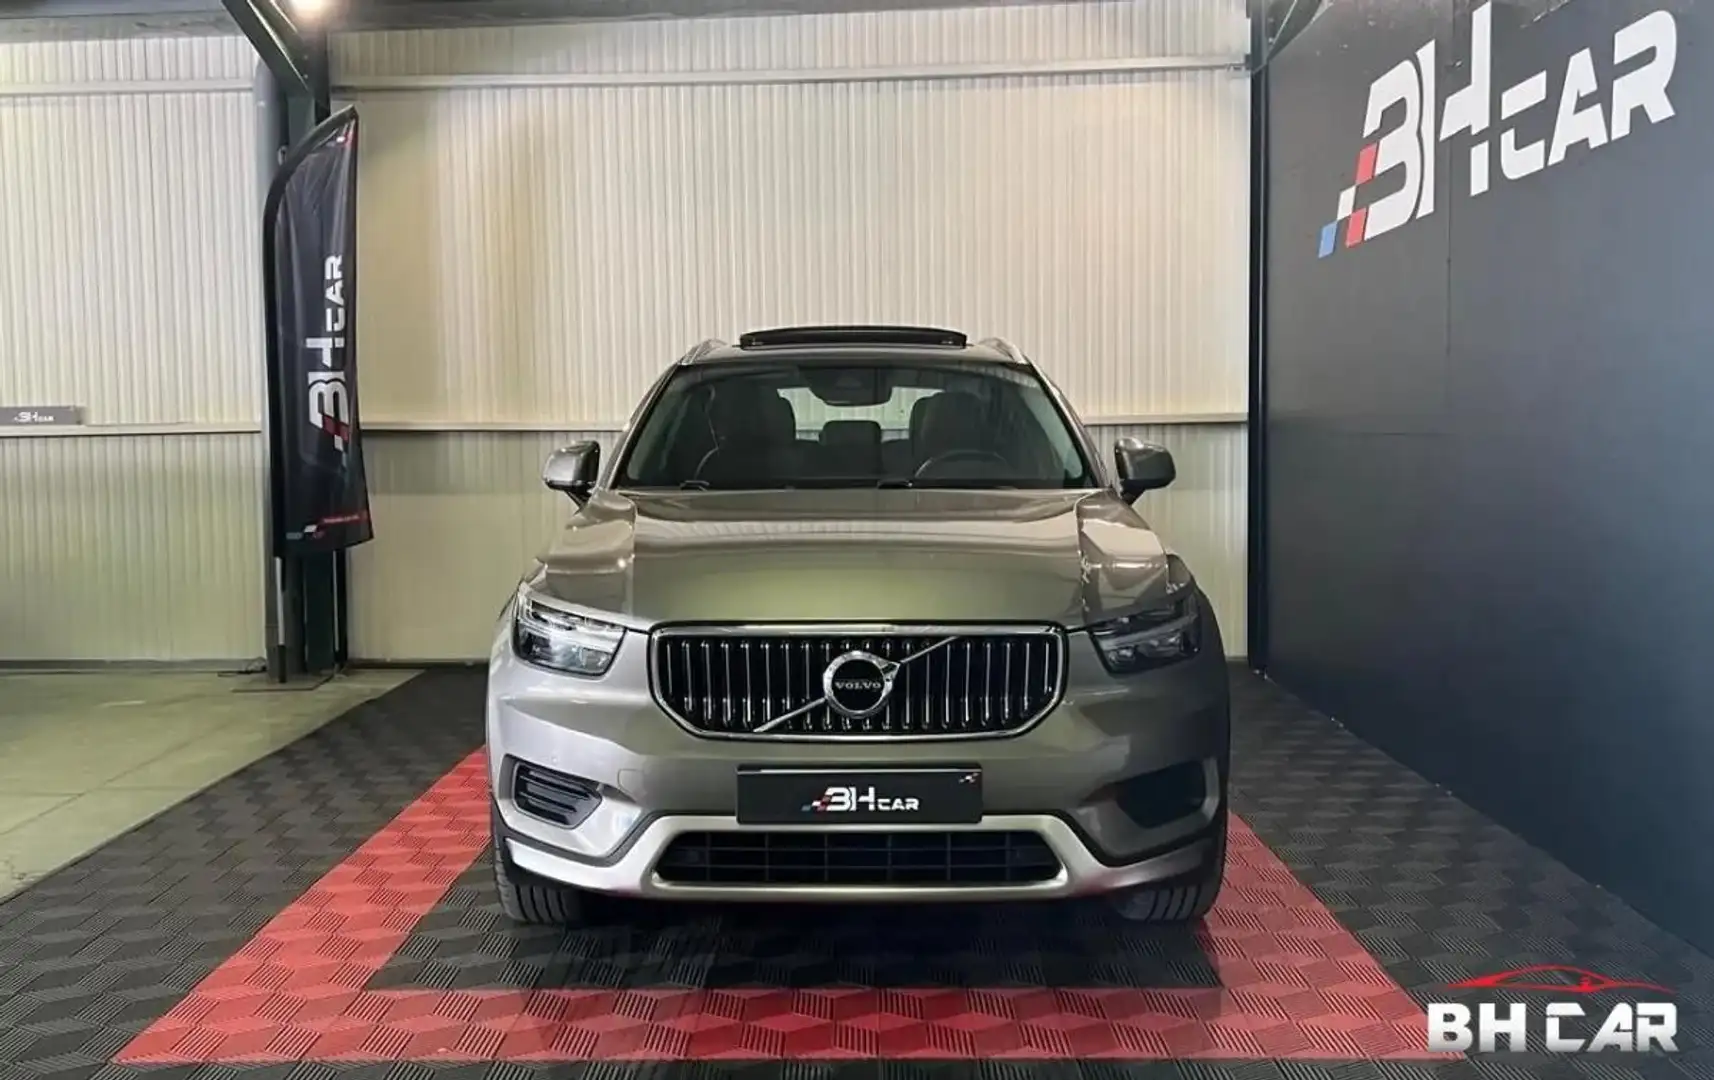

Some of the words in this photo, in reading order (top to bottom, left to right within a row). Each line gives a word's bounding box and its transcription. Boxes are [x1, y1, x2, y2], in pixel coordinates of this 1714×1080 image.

[1500, 9, 1678, 180] CAR
[324, 254, 346, 332] CAR
[834, 682, 881, 690] VOLVO
[877, 798, 919, 811] CAR
